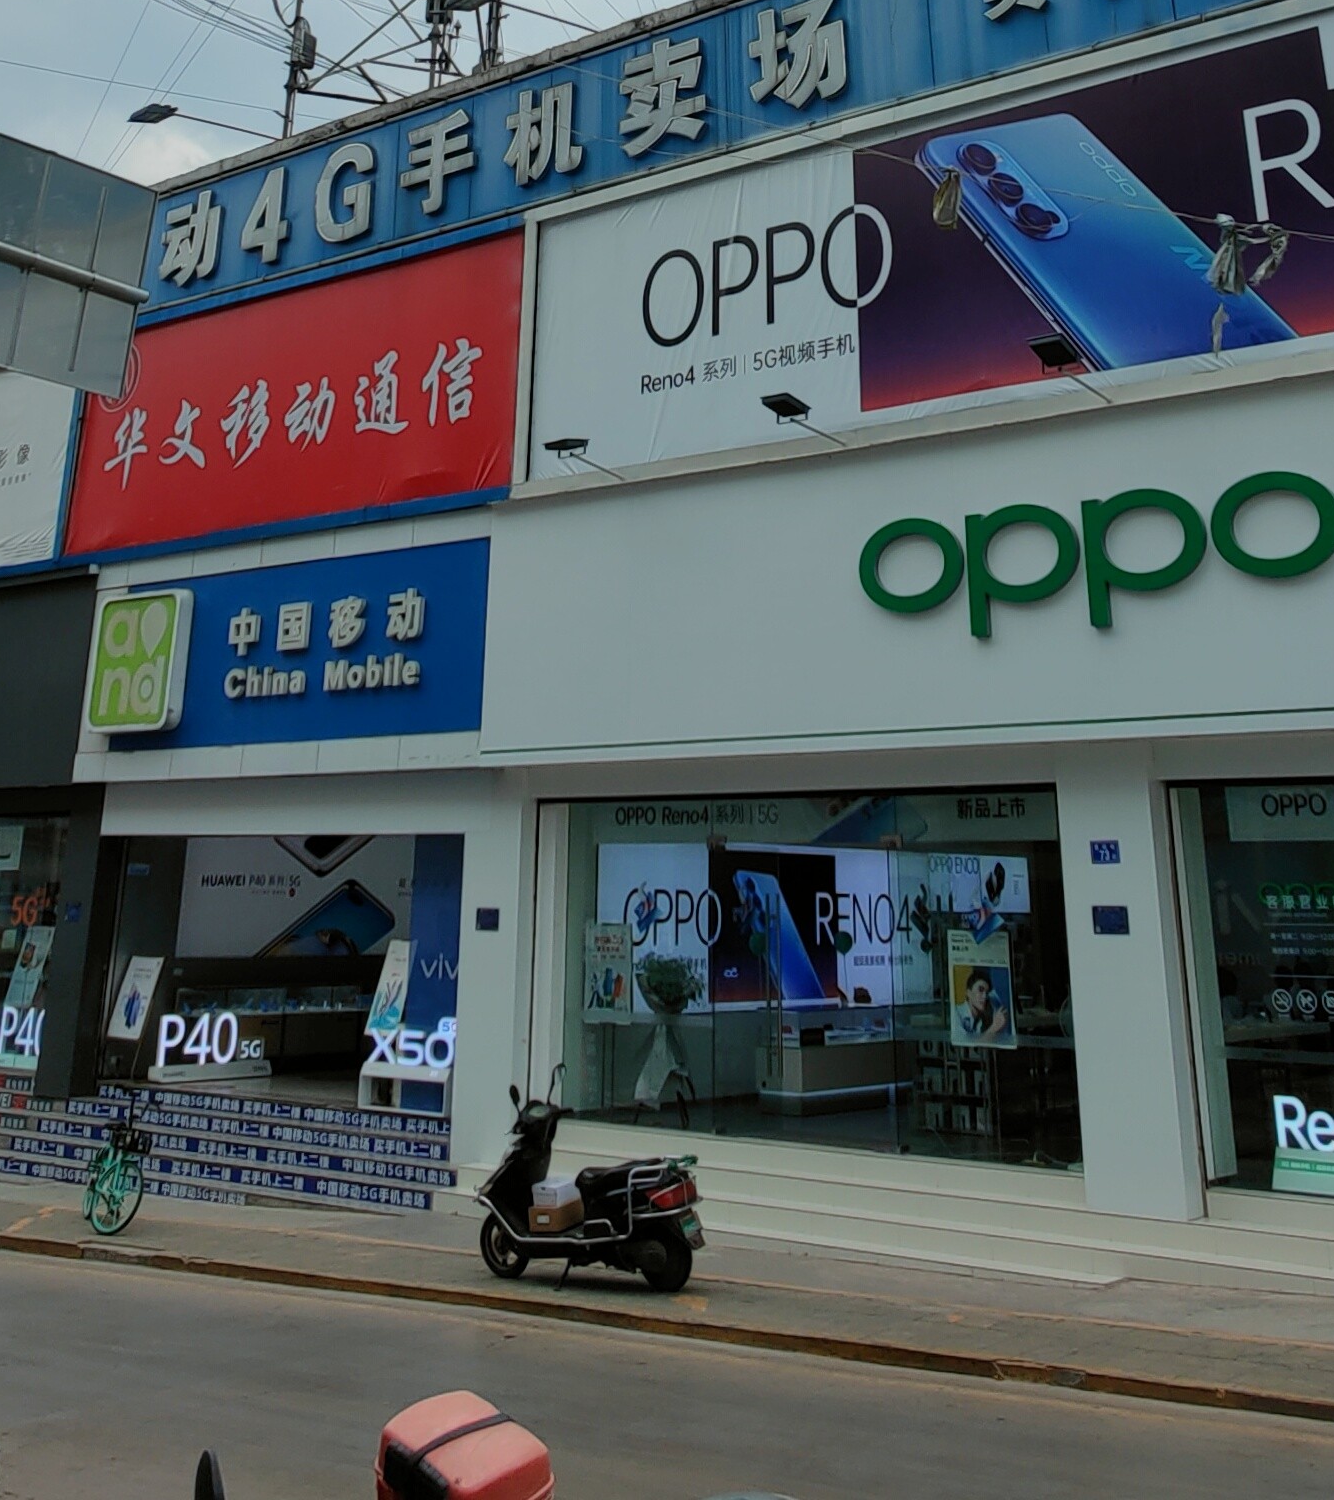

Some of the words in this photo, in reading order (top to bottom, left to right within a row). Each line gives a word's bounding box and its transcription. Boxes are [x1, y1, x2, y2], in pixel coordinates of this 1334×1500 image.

[641, 203, 894, 348] OPPO
[641, 364, 696, 396] Reno4
[702, 357, 738, 384] 系列
[752, 333, 855, 373] 5G视频手机
[104, 337, 485, 490] 华文移动通信
[227, 587, 427, 657] 中国移动
[224, 665, 306, 701] China
[322, 651, 422, 692] Mobile
[614, 806, 657, 826] OPPO
[661, 805, 709, 825] Reno4
[956, 797, 1026, 819] 新品上市
[1260, 793, 1327, 817] OPPO
[201, 874, 246, 887] HUAWEI
[156, 1011, 239, 1068] P40
[239, 1039, 262, 1059] 5G
[365, 1027, 455, 1069] X50
[211, 1118, 269, 1139] 买手机上二楼
[272, 1125, 370, 1152] 中国移动5G手机卖场
[373, 1139, 442, 1159] 买手机上二楼
[242, 1100, 300, 1120] 买手机上二楼
[303, 1107, 402, 1132] 中国移动5G手机卖场
[170, 1160, 231, 1181] 买手机上二楼
[241, 1169, 304, 1191] 买手机上二楼
[316, 1180, 426, 1209] 中国移动5G手机卖场
[197, 1139, 257, 1160] 买手机上二楼
[266, 1148, 330, 1169] 买手机上二楼
[341, 1157, 451, 1186] 中国移动5G手机卖场
